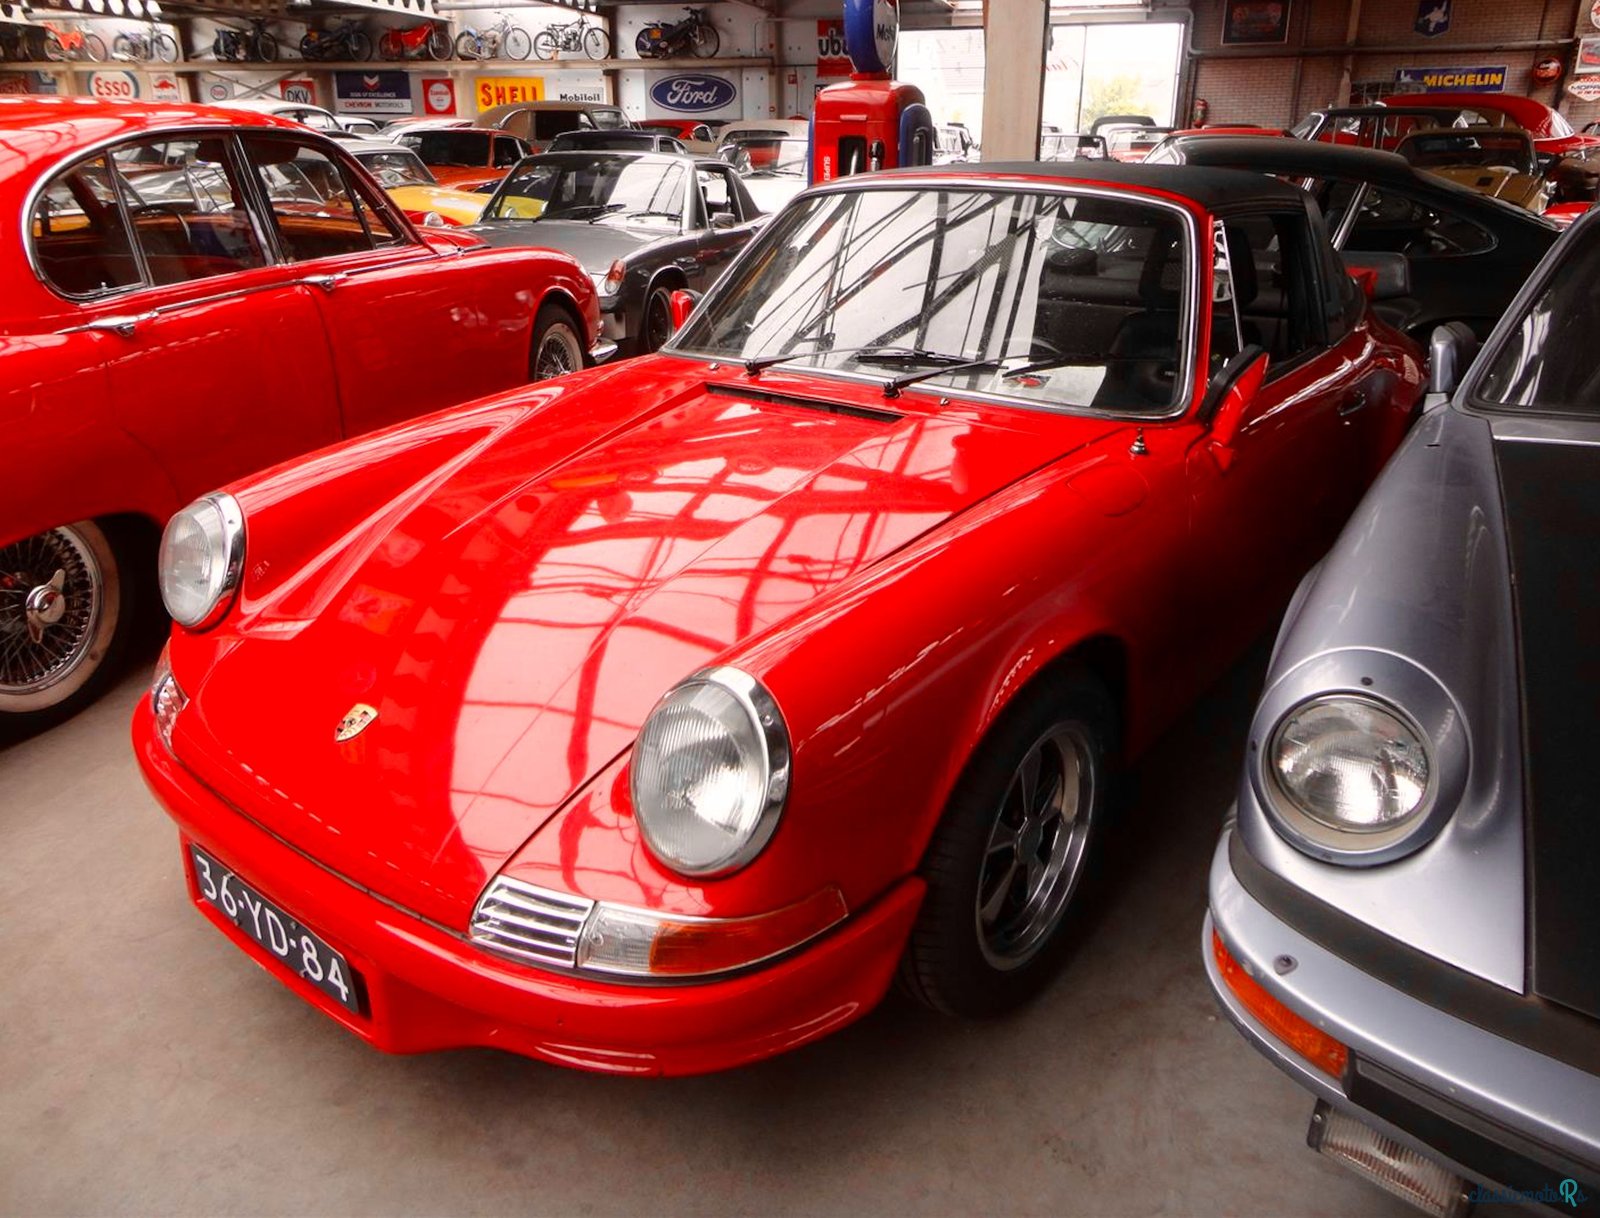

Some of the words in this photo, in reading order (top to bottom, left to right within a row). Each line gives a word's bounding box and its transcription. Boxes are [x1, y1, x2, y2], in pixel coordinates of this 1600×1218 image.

[1423, 73, 1502, 87] MICHELIN
[287, 90, 308, 104] DKV
[560, 93, 601, 102] Mobiloil
[667, 79, 718, 104] Ford
[344, 101, 372, 109] CHEVRON
[196, 855, 350, 1002] 36-YD-84
